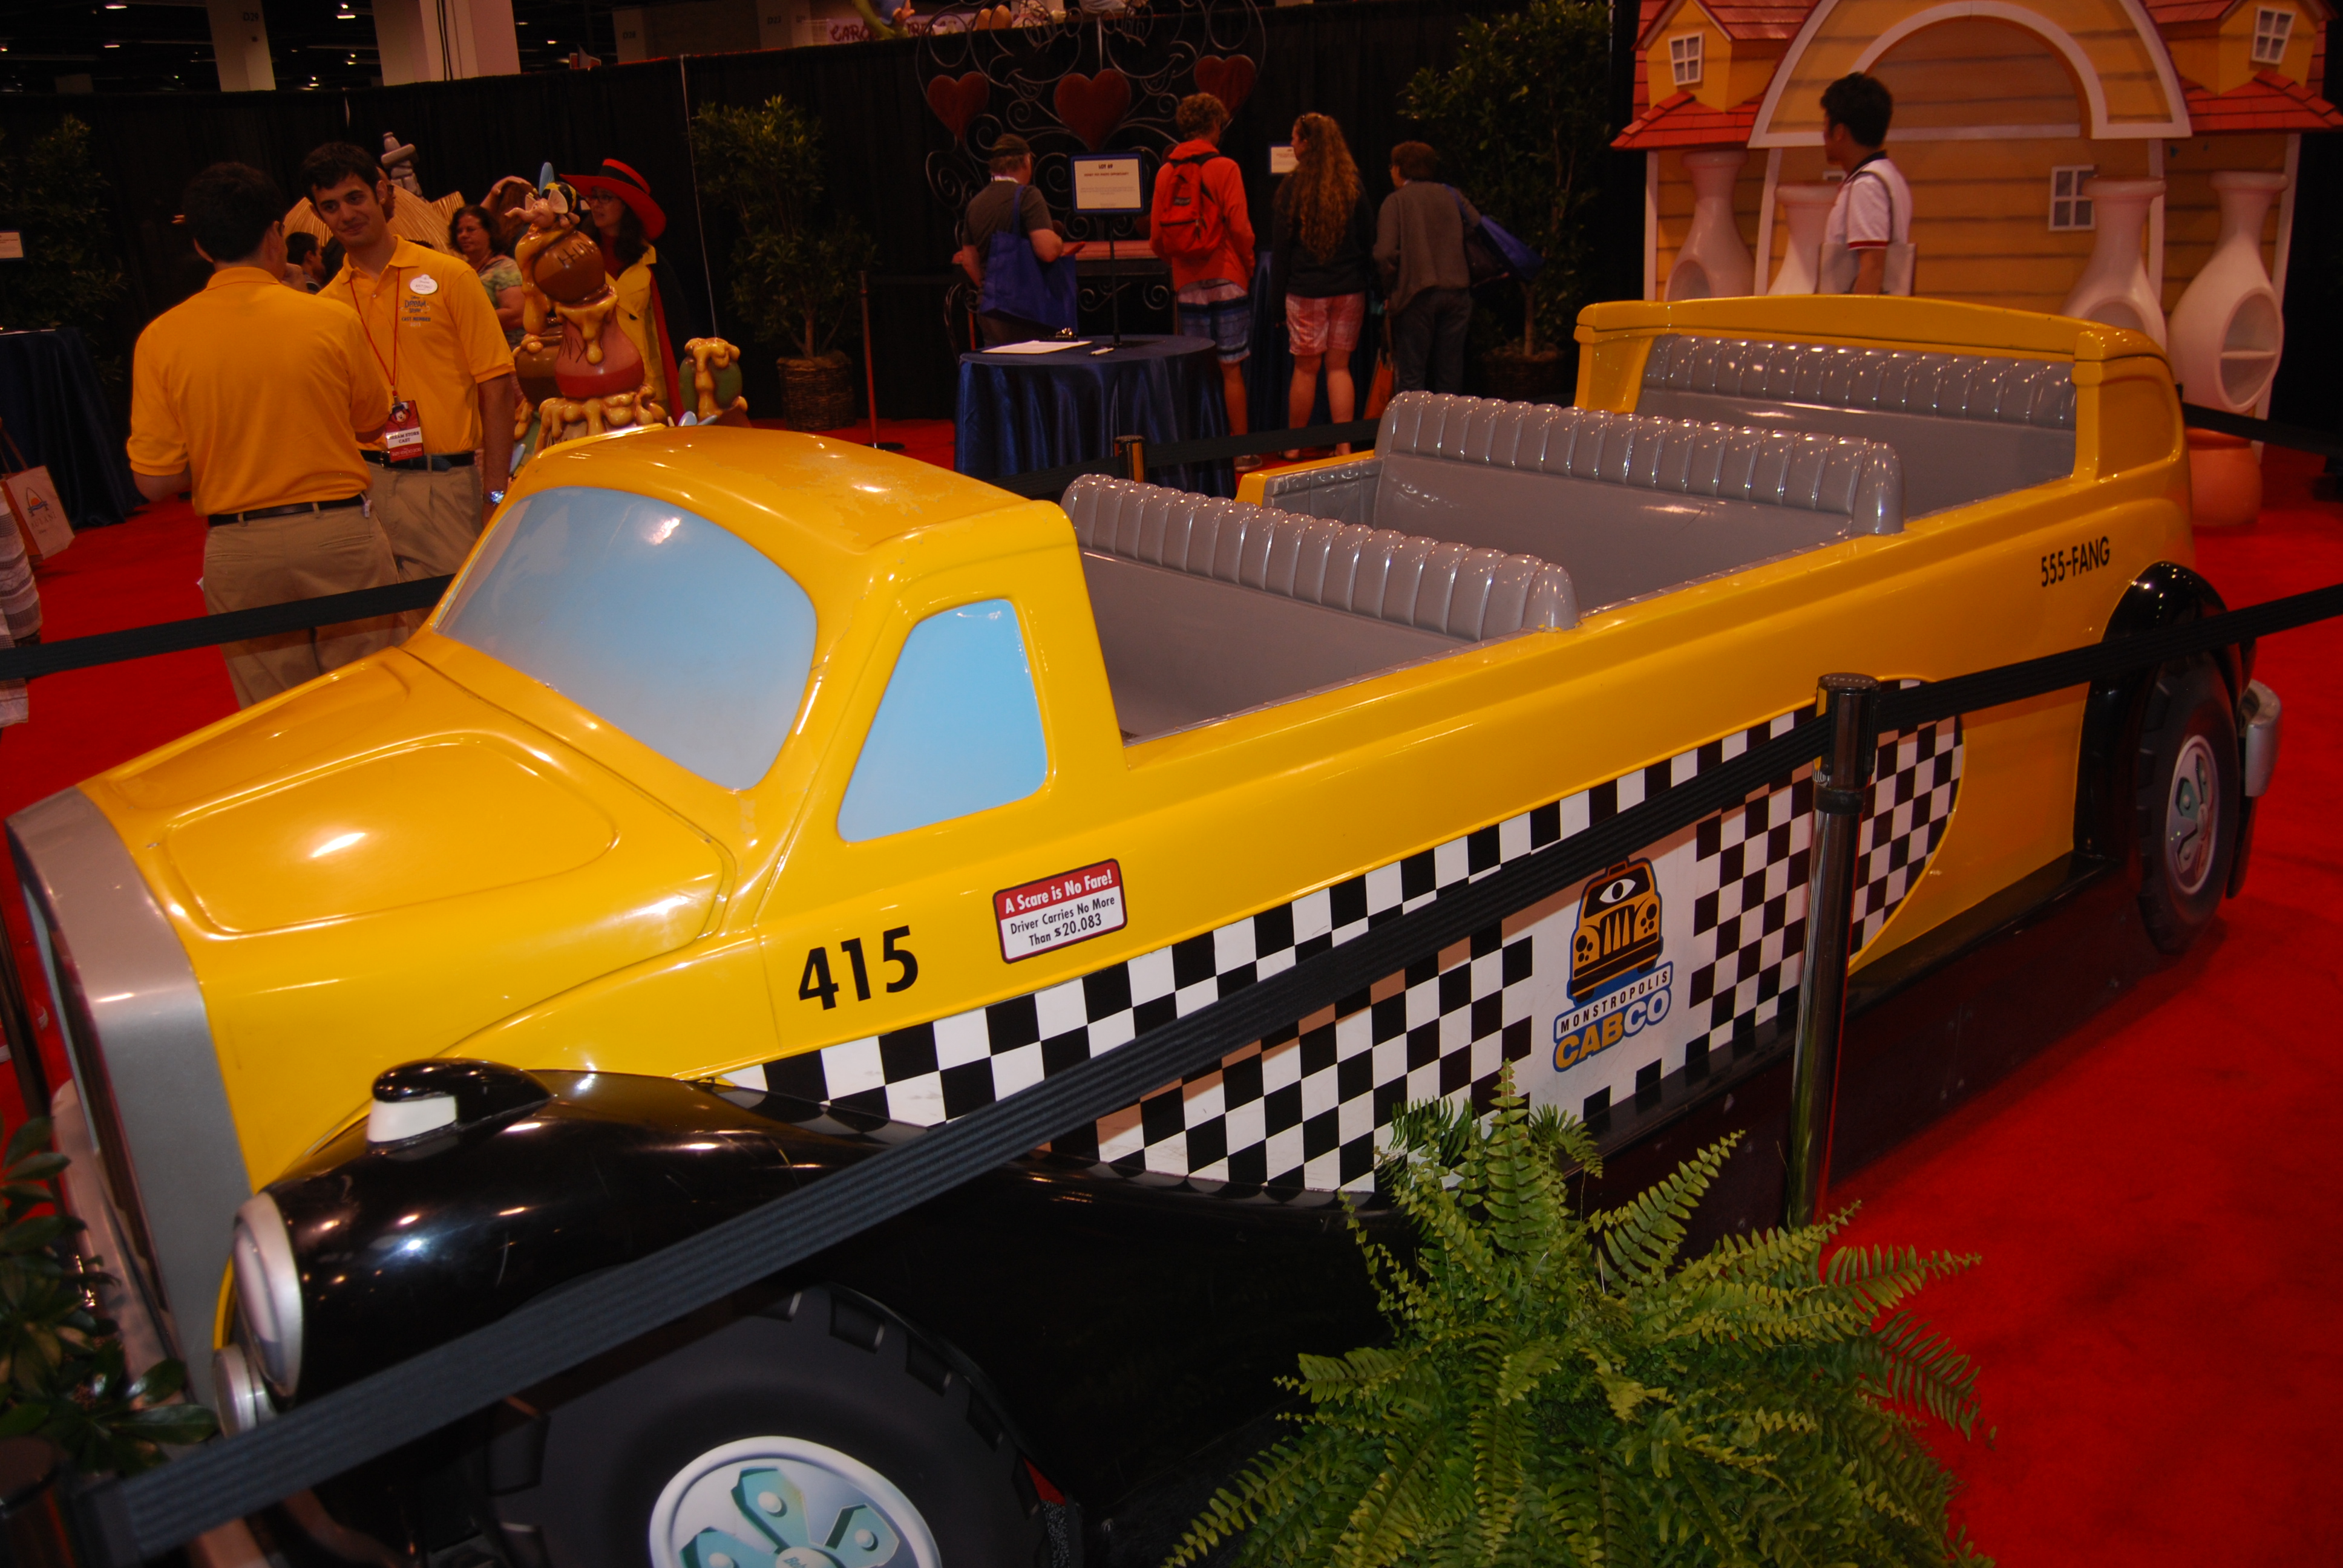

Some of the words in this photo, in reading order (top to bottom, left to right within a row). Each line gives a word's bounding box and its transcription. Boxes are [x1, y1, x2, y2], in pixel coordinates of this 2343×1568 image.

[243, 12, 259, 21] D29
[2042, 536, 2109, 587] 555-FANG
[1006, 898, 1015, 914] A
[1017, 893, 1049, 910] Scare
[1050, 886, 1062, 900] is
[1064, 880, 1082, 897] No
[1084, 869, 1113, 890] Fare!
[1011, 918, 1039, 935] Driver
[1042, 909, 1074, 925] Carries
[1077, 903, 1089, 915] No
[1092, 897, 1115, 910] More
[1029, 933, 1051, 946] Than
[798, 925, 919, 1010] 415
[1561, 970, 1668, 1033] MONSTROPOLIS
[1555, 988, 1671, 1070] CABCO
